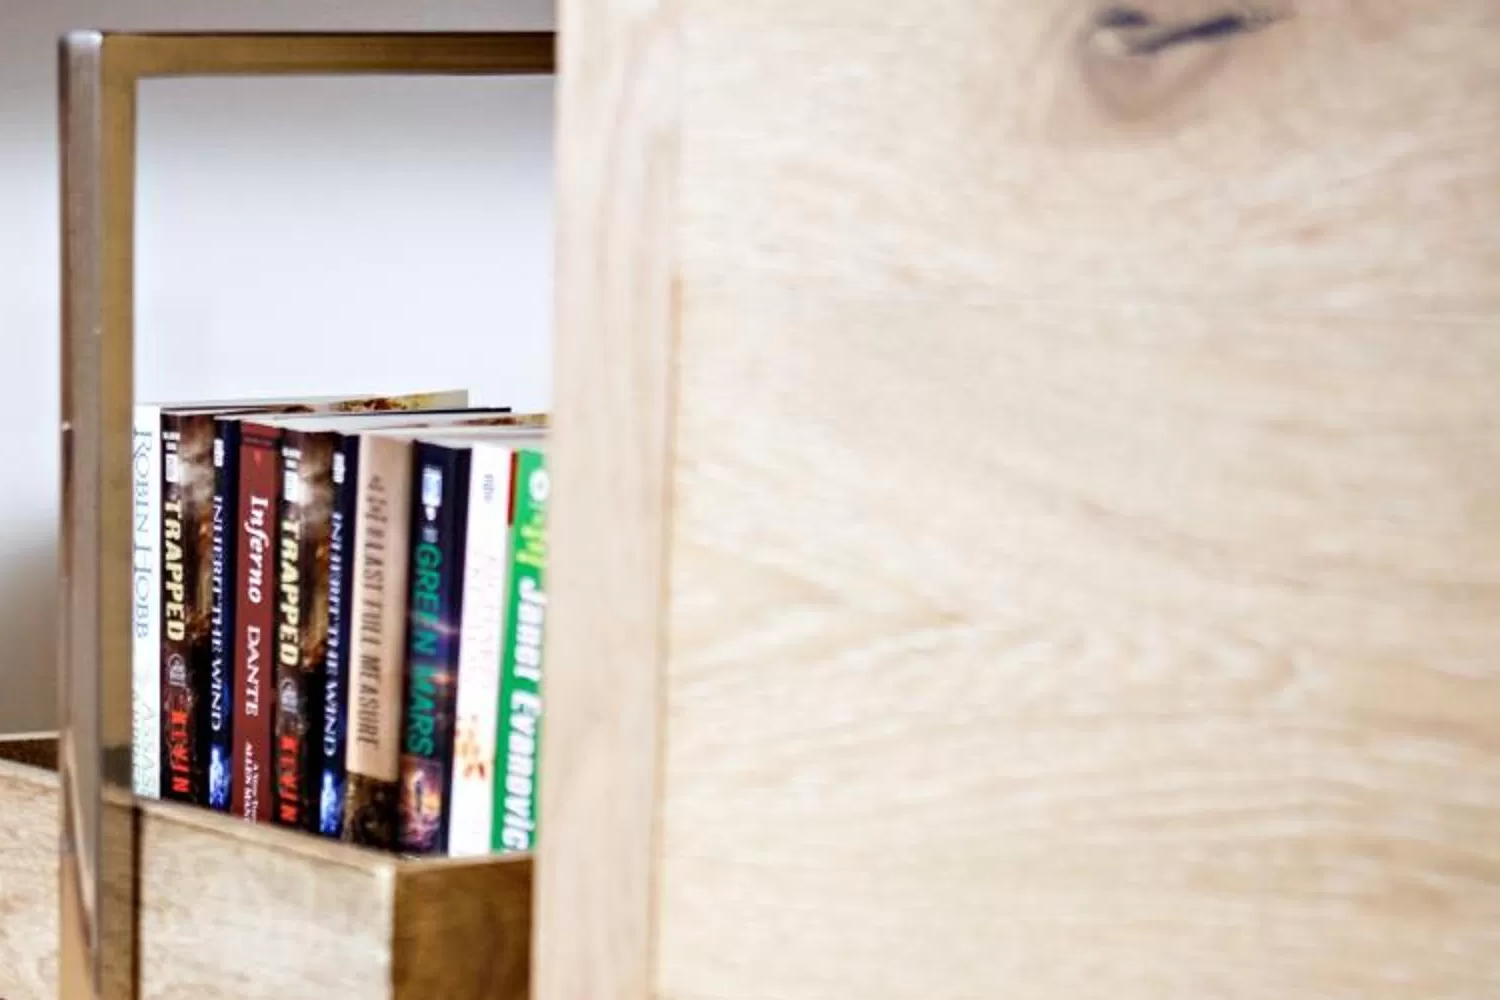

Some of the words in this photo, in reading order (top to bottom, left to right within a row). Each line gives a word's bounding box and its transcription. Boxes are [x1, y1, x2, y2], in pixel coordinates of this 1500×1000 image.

[132, 428, 153, 533] ROBIN
[133, 543, 153, 639] HOBB
[162, 499, 184, 641] TRAPPED
[211, 495, 224, 595] INHERIT
[247, 494, 269, 605] Inferno
[330, 512, 344, 615] INHERIT
[364, 543, 385, 592] LAST
[211, 600, 222, 654] THE
[280, 520, 300, 665] TRAPPED
[360, 598, 384, 646] FULL
[414, 542, 443, 655] GREEN
[515, 577, 544, 679] Janet
[210, 657, 221, 731] WIND
[245, 625, 261, 718] DANTE
[328, 619, 341, 676] THE
[324, 681, 337, 756] WIND
[357, 655, 382, 750] MEASURE
[407, 662, 436, 755] MARS
[170, 707, 190, 793] KEVIN
[244, 741, 253, 785] ALLEN
[276, 735, 296, 822] KEVIN
[502, 688, 539, 852] Evanovic
